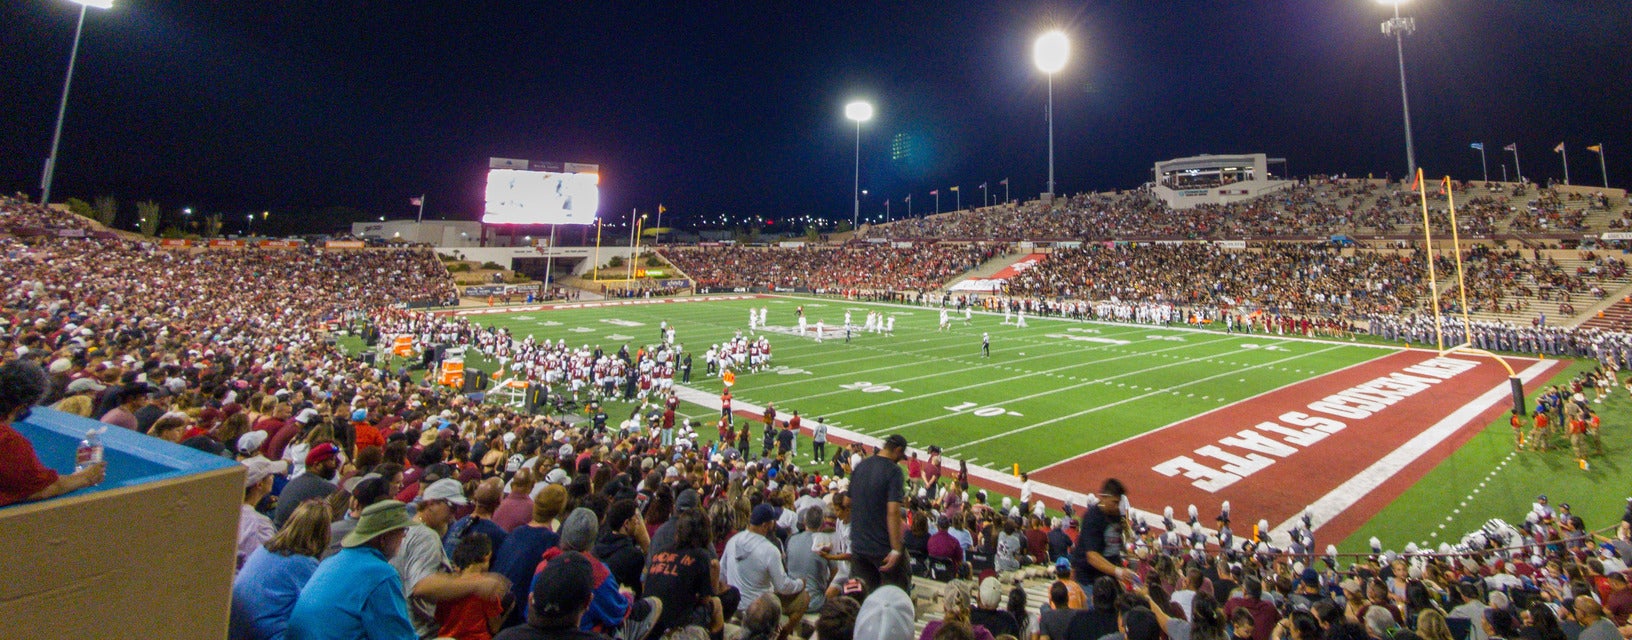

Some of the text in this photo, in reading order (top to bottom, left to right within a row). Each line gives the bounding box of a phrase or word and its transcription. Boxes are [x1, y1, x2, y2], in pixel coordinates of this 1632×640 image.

[942, 402, 1005, 417] 10
[1151, 356, 1482, 494] NEW MEXICO STATE
